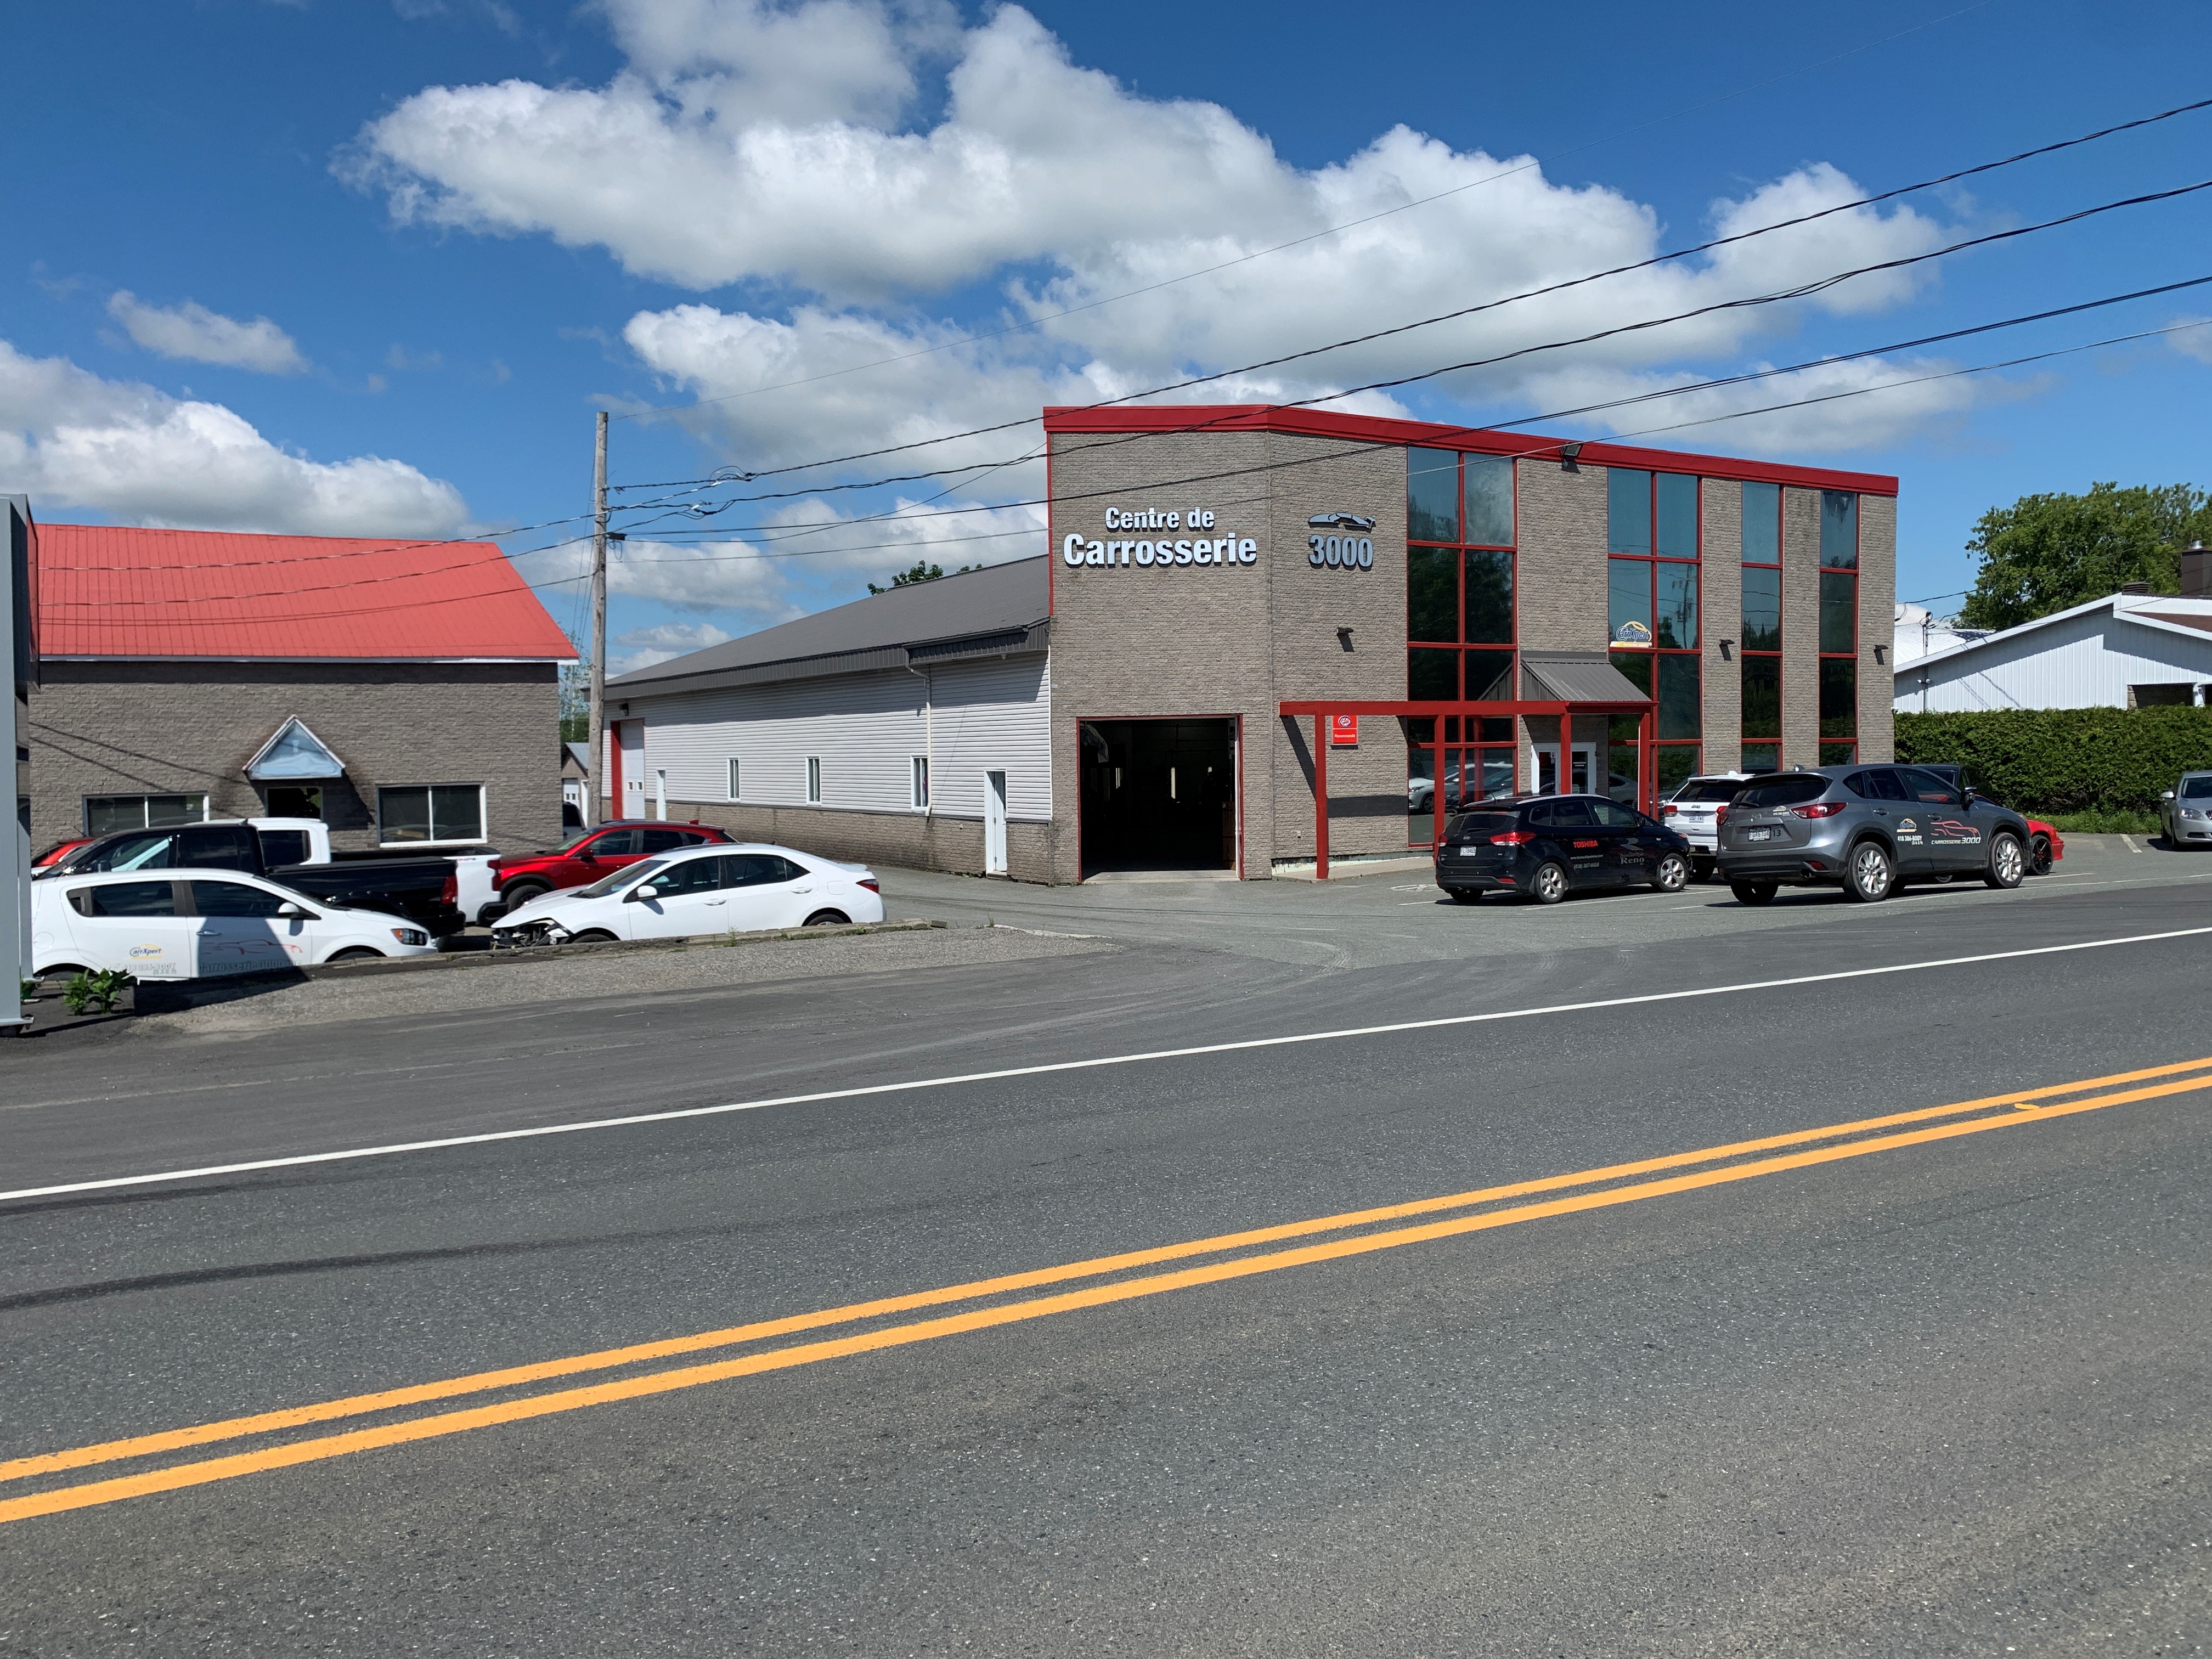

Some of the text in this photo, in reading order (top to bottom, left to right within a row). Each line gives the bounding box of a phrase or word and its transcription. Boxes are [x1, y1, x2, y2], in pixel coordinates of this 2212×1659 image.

[1105, 506, 1214, 530] Centre de
[1063, 533, 1257, 565] Carrosserie
[1309, 534, 1374, 567] 3000
[1573, 840, 1599, 848] TOSHIBA
[129, 947, 161, 957] CarrXpert
